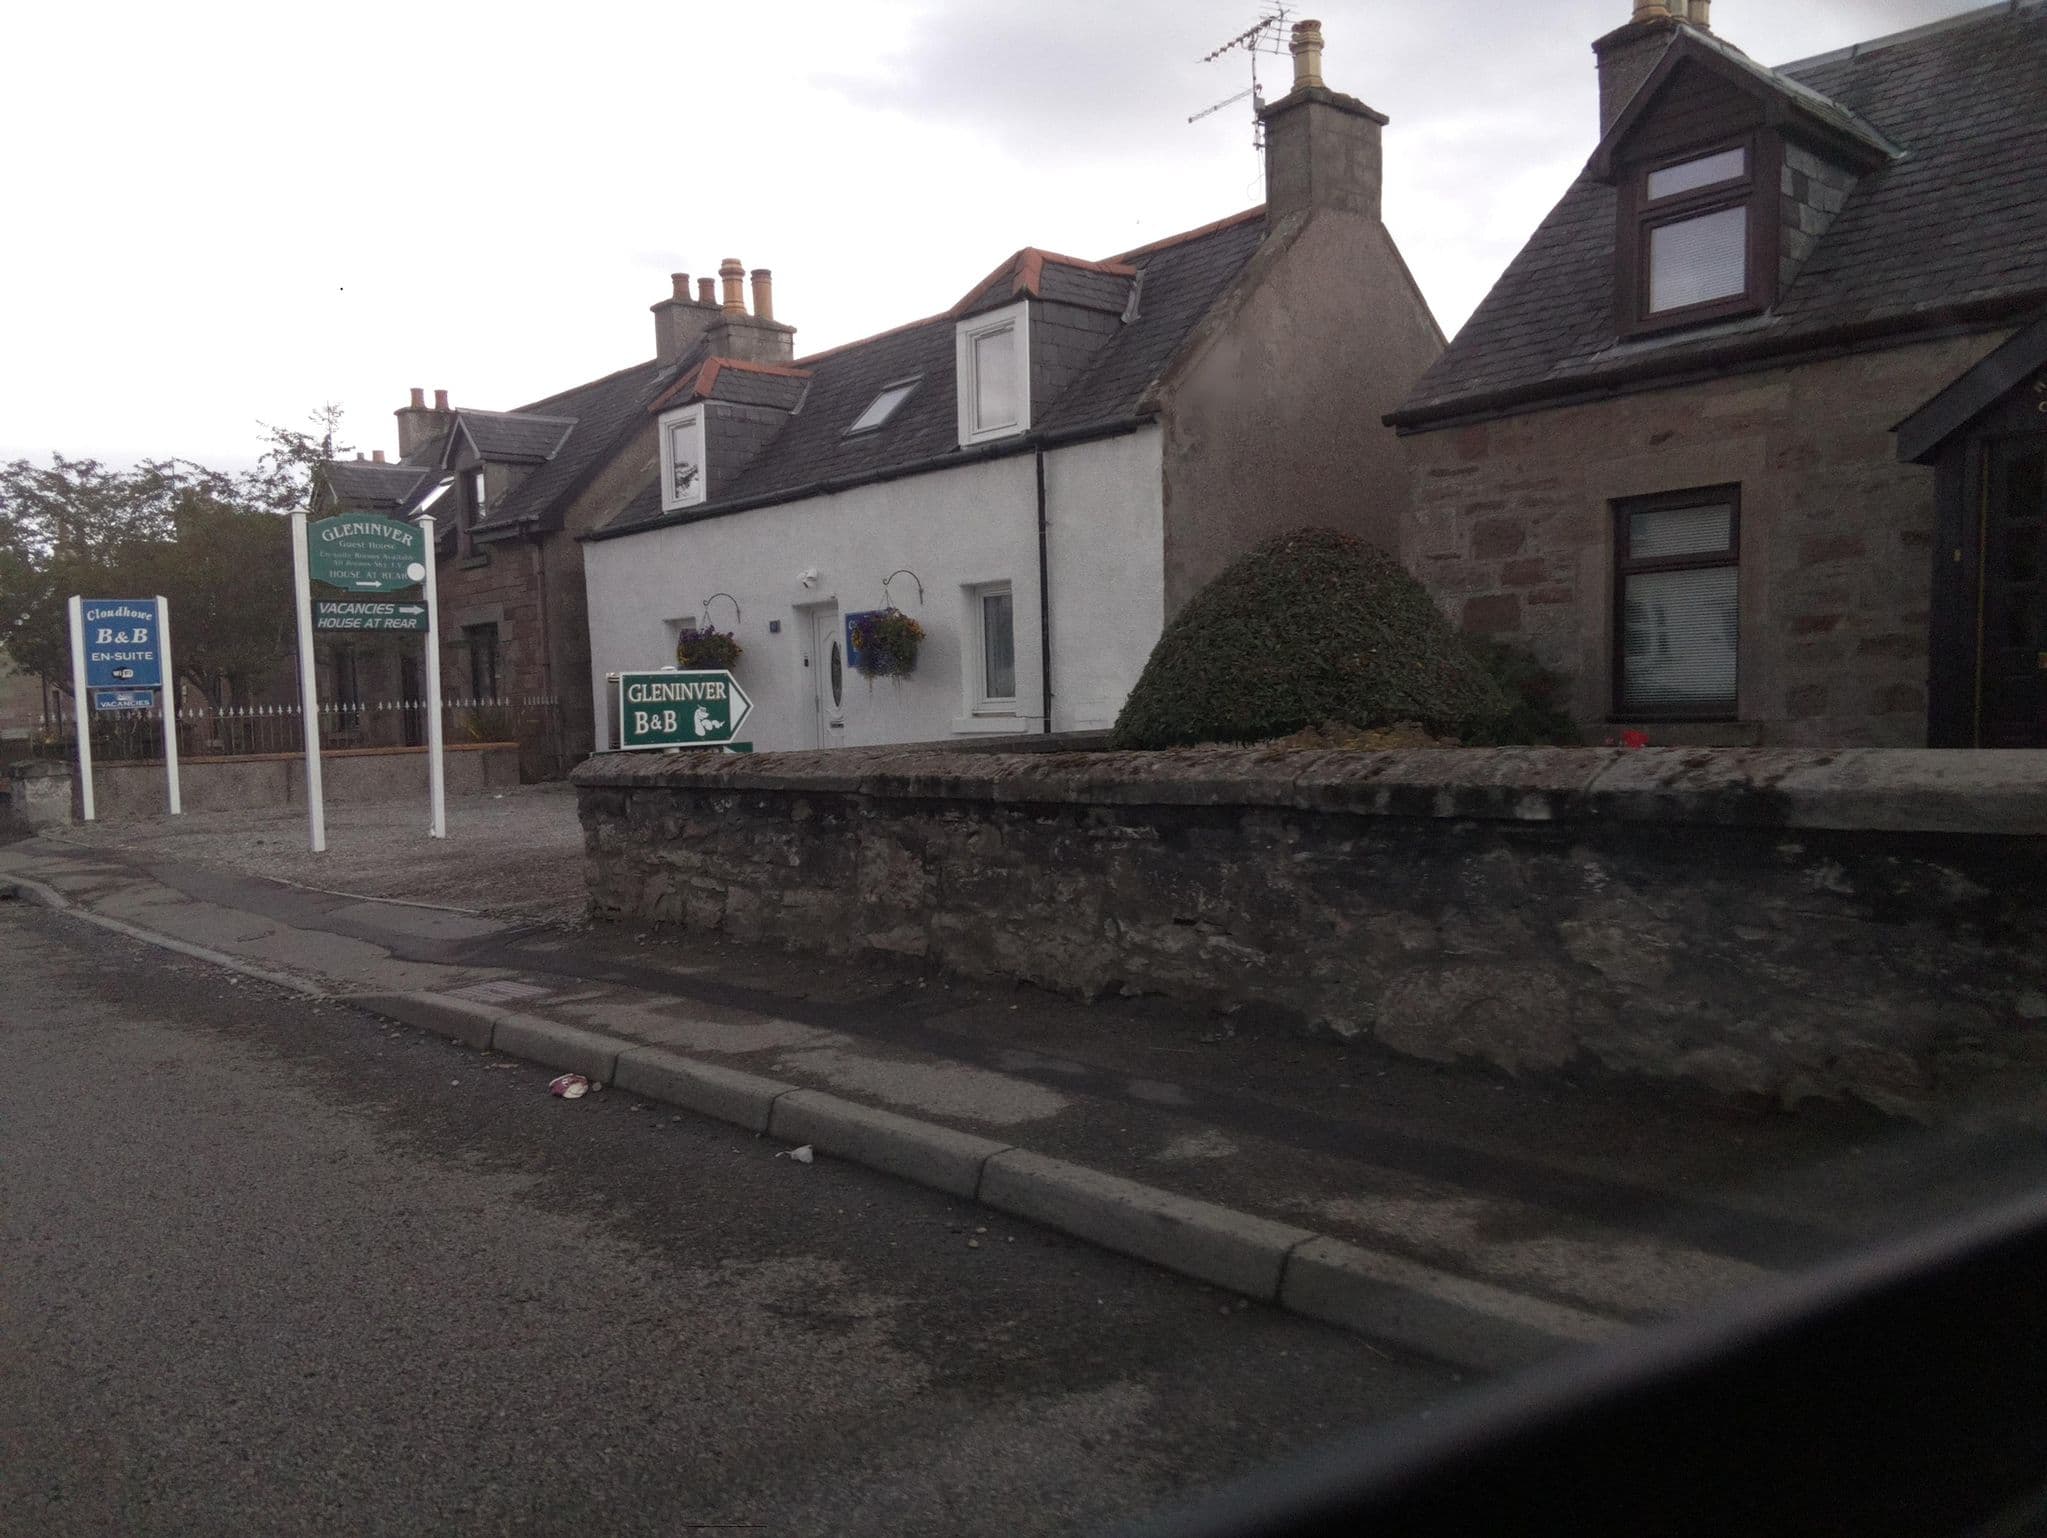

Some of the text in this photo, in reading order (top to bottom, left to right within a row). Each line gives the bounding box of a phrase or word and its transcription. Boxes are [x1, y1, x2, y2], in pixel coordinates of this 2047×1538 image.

[321, 522, 413, 547] GLENINVER
[339, 540, 366, 549] Guest
[329, 569, 361, 579] HOUSE
[366, 571, 377, 580] AT
[86, 606, 153, 621] Cloudhowe
[319, 602, 395, 615] VACANCIES
[318, 618, 417, 629] HOUSE AT REAR
[95, 627, 149, 644] B&B
[91, 651, 153, 662] EN-SUITE
[628, 681, 727, 703] GLENINVER
[100, 699, 150, 709] VACANCIES
[634, 709, 678, 735] B&B
